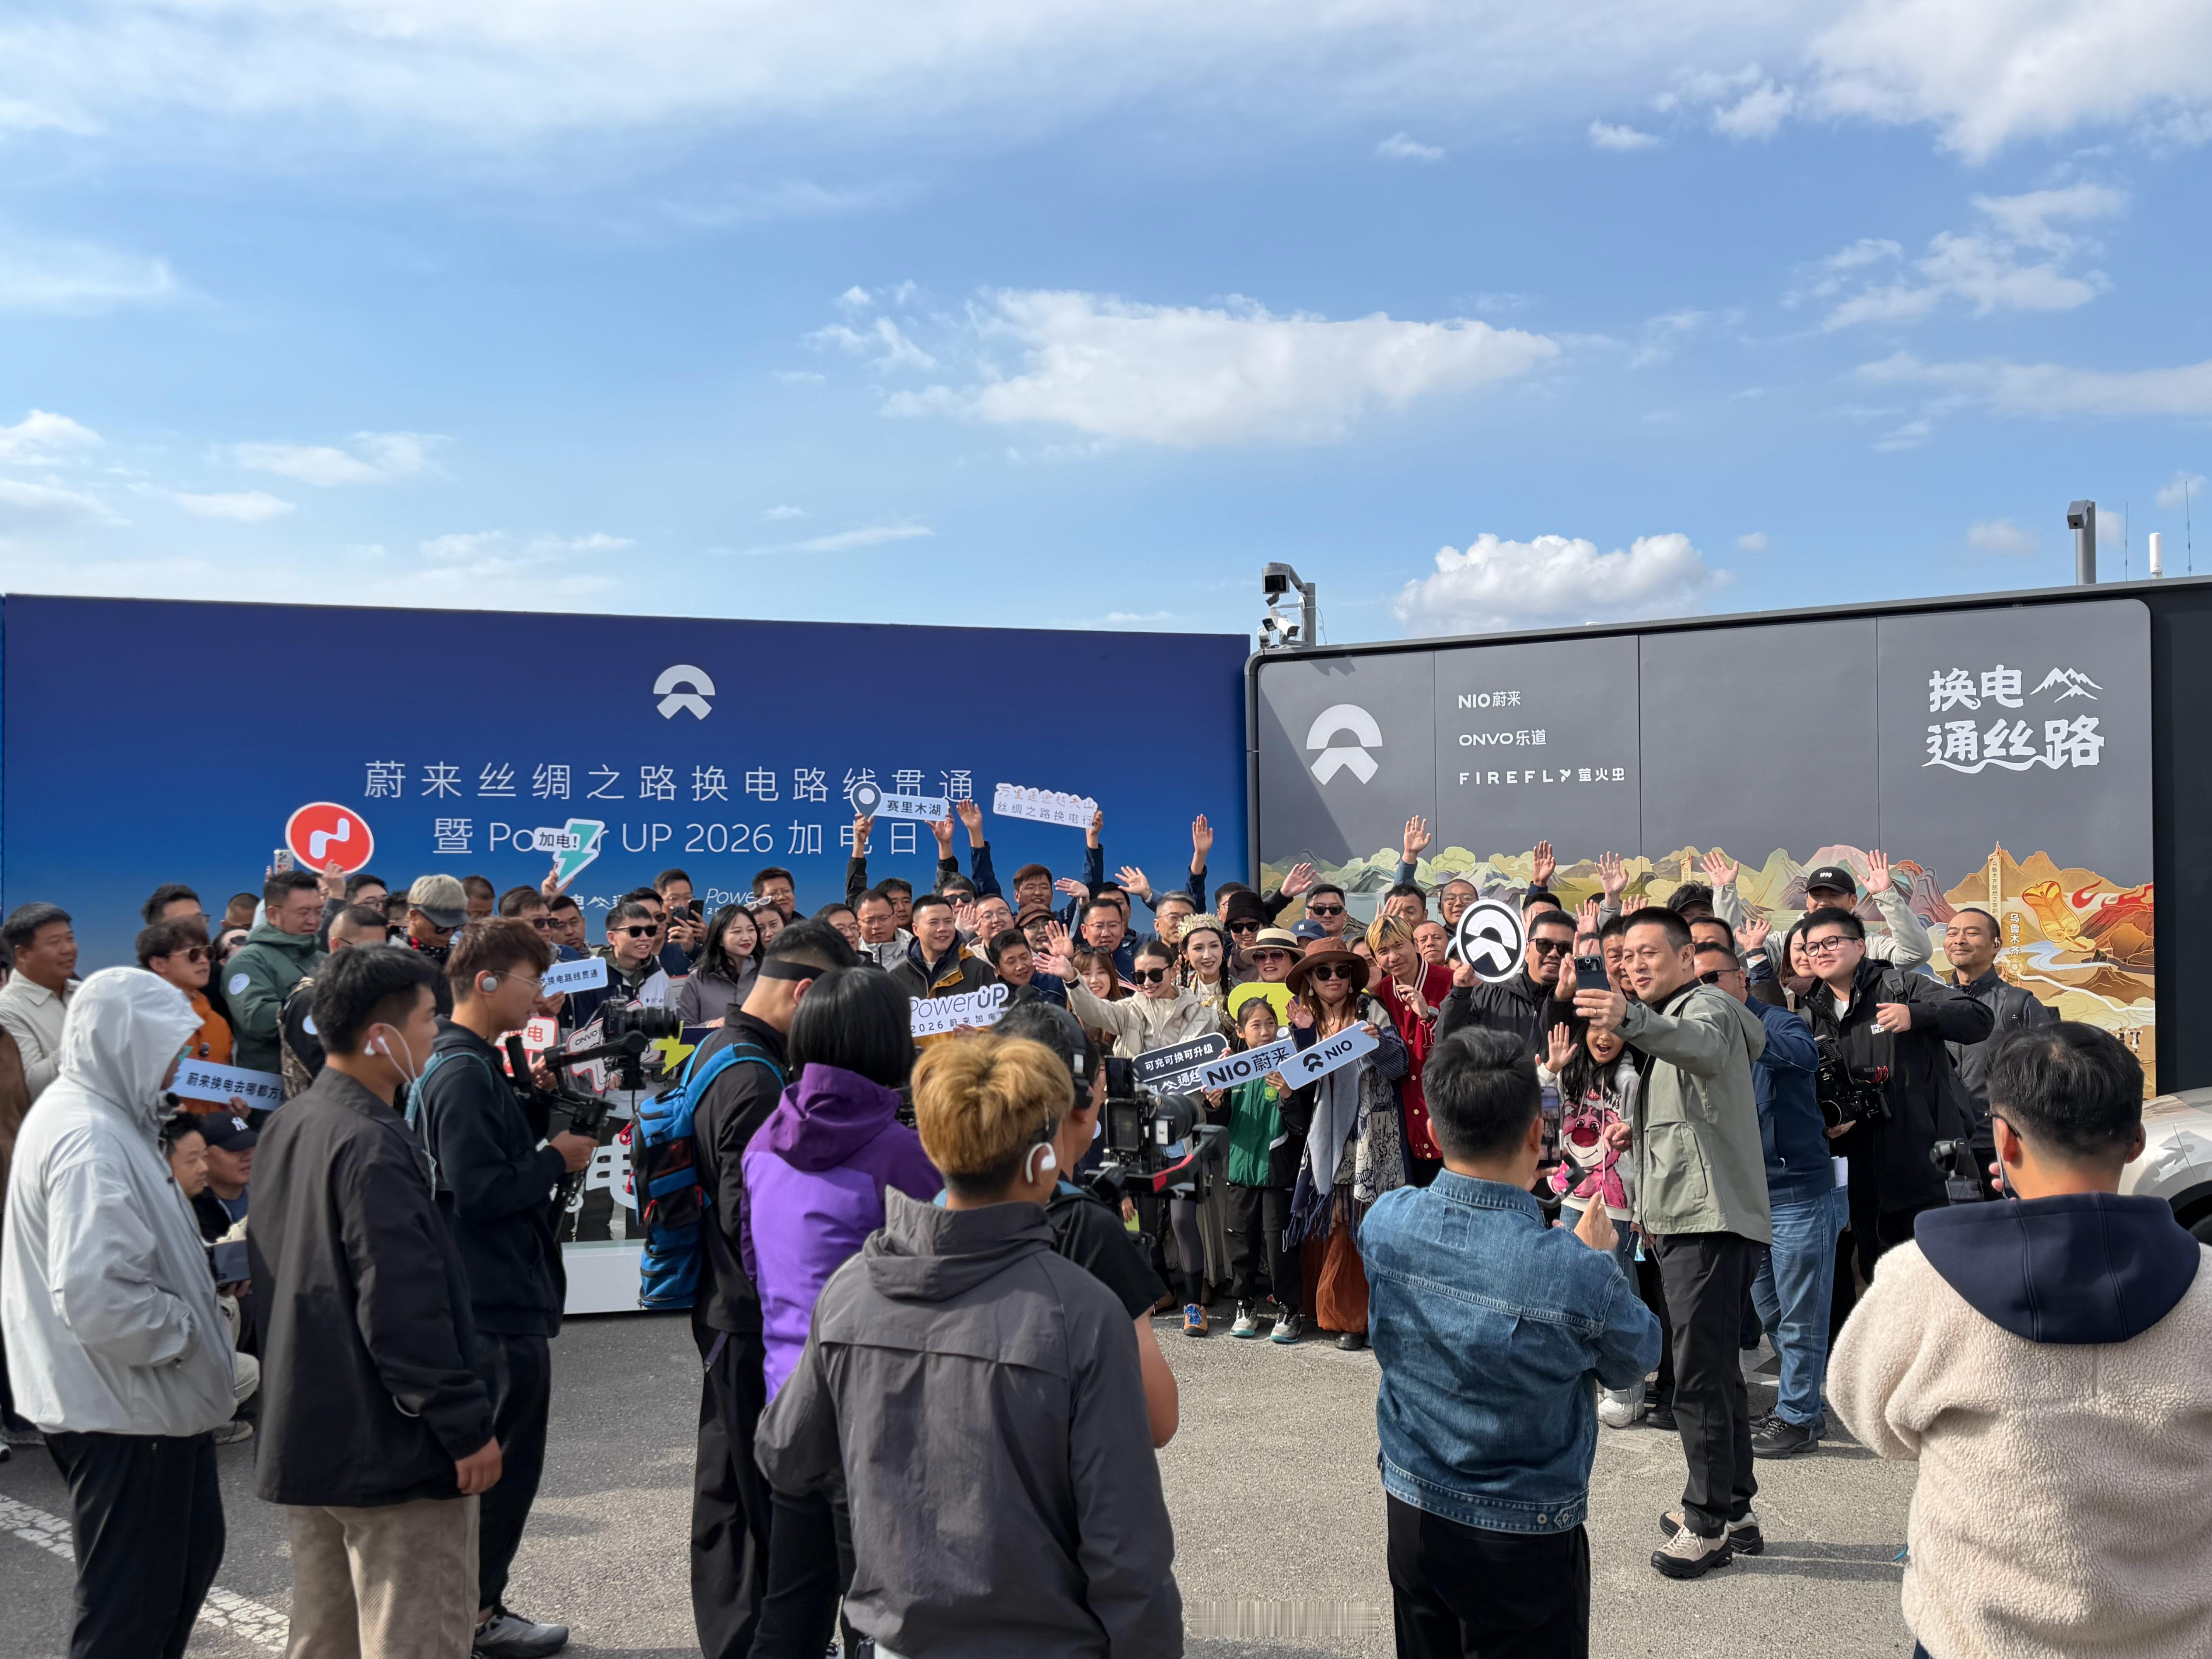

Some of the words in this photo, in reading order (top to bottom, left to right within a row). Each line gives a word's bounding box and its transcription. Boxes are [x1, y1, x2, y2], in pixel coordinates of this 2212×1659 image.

[1929, 665, 2024, 712] 换电
[1922, 714, 2105, 774] 通丝路
[364, 760, 973, 802] 蔚来丝绸之路换电路线贯通
[1459, 769, 1571, 785] FIREFLY
[1578, 768, 1625, 782] 萤火虫
[887, 800, 941, 816] 赛里木湖
[997, 801, 1092, 826] 丝绸之路换电行
[432, 818, 473, 854] 暨
[490, 823, 610, 852] Por
[622, 823, 672, 852] UP
[685, 823, 774, 853] 2026
[539, 832, 577, 848] 加电!
[706, 888, 755, 904] Powe
[2009, 912, 2021, 955] 乌鲁木齐
[950, 1011, 1002, 1027] 蔚来加电
[1144, 1043, 1214, 1071] 可充可换可升级
[1324, 1040, 1353, 1060] NIO
